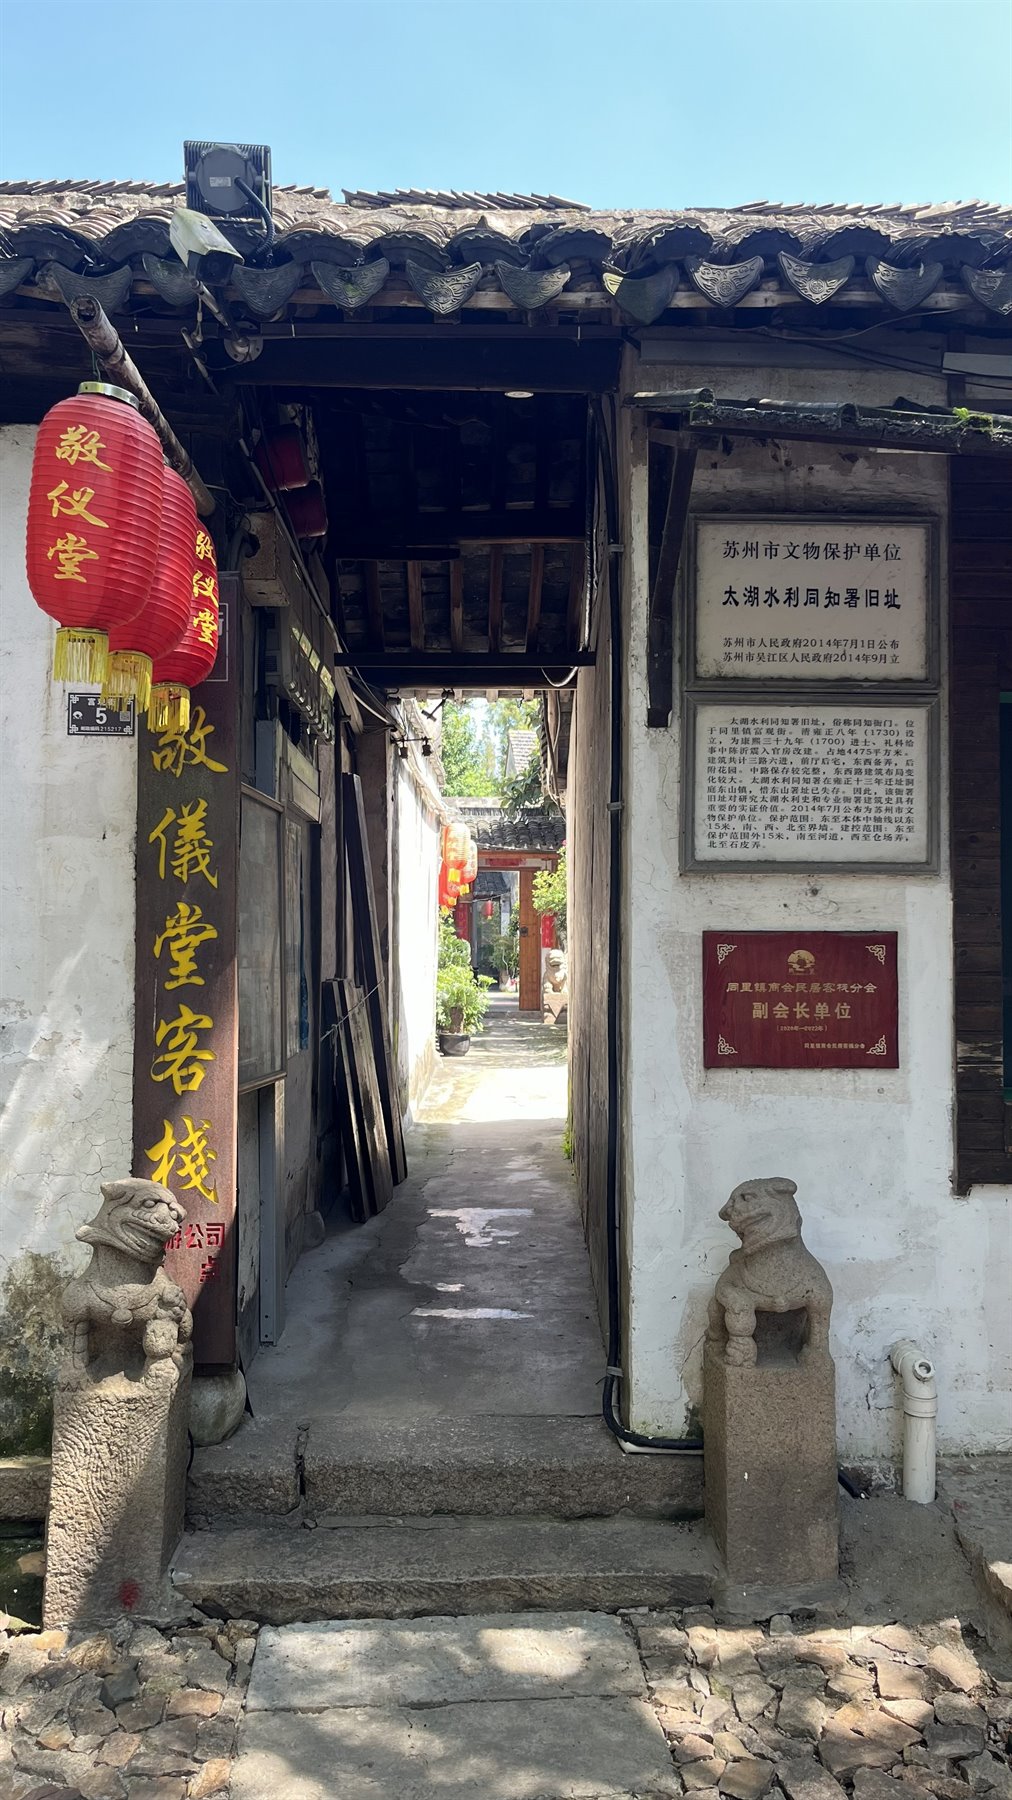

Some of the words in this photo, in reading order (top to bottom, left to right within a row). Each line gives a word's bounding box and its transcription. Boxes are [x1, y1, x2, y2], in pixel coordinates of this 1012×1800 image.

[47, 424, 114, 584] 敬仪堂
[722, 540, 902, 562] 苏州市文物保护单位
[721, 585, 902, 610] 太湖水利同知署旧址
[722, 637, 900, 650] 苏州市人民政府2014年7月1日公布
[722, 651, 900, 664] 苏州市吴江区人民政府2014年9月立
[95, 707, 108, 725] 5
[752, 1002, 852, 1020] 副会长单位
